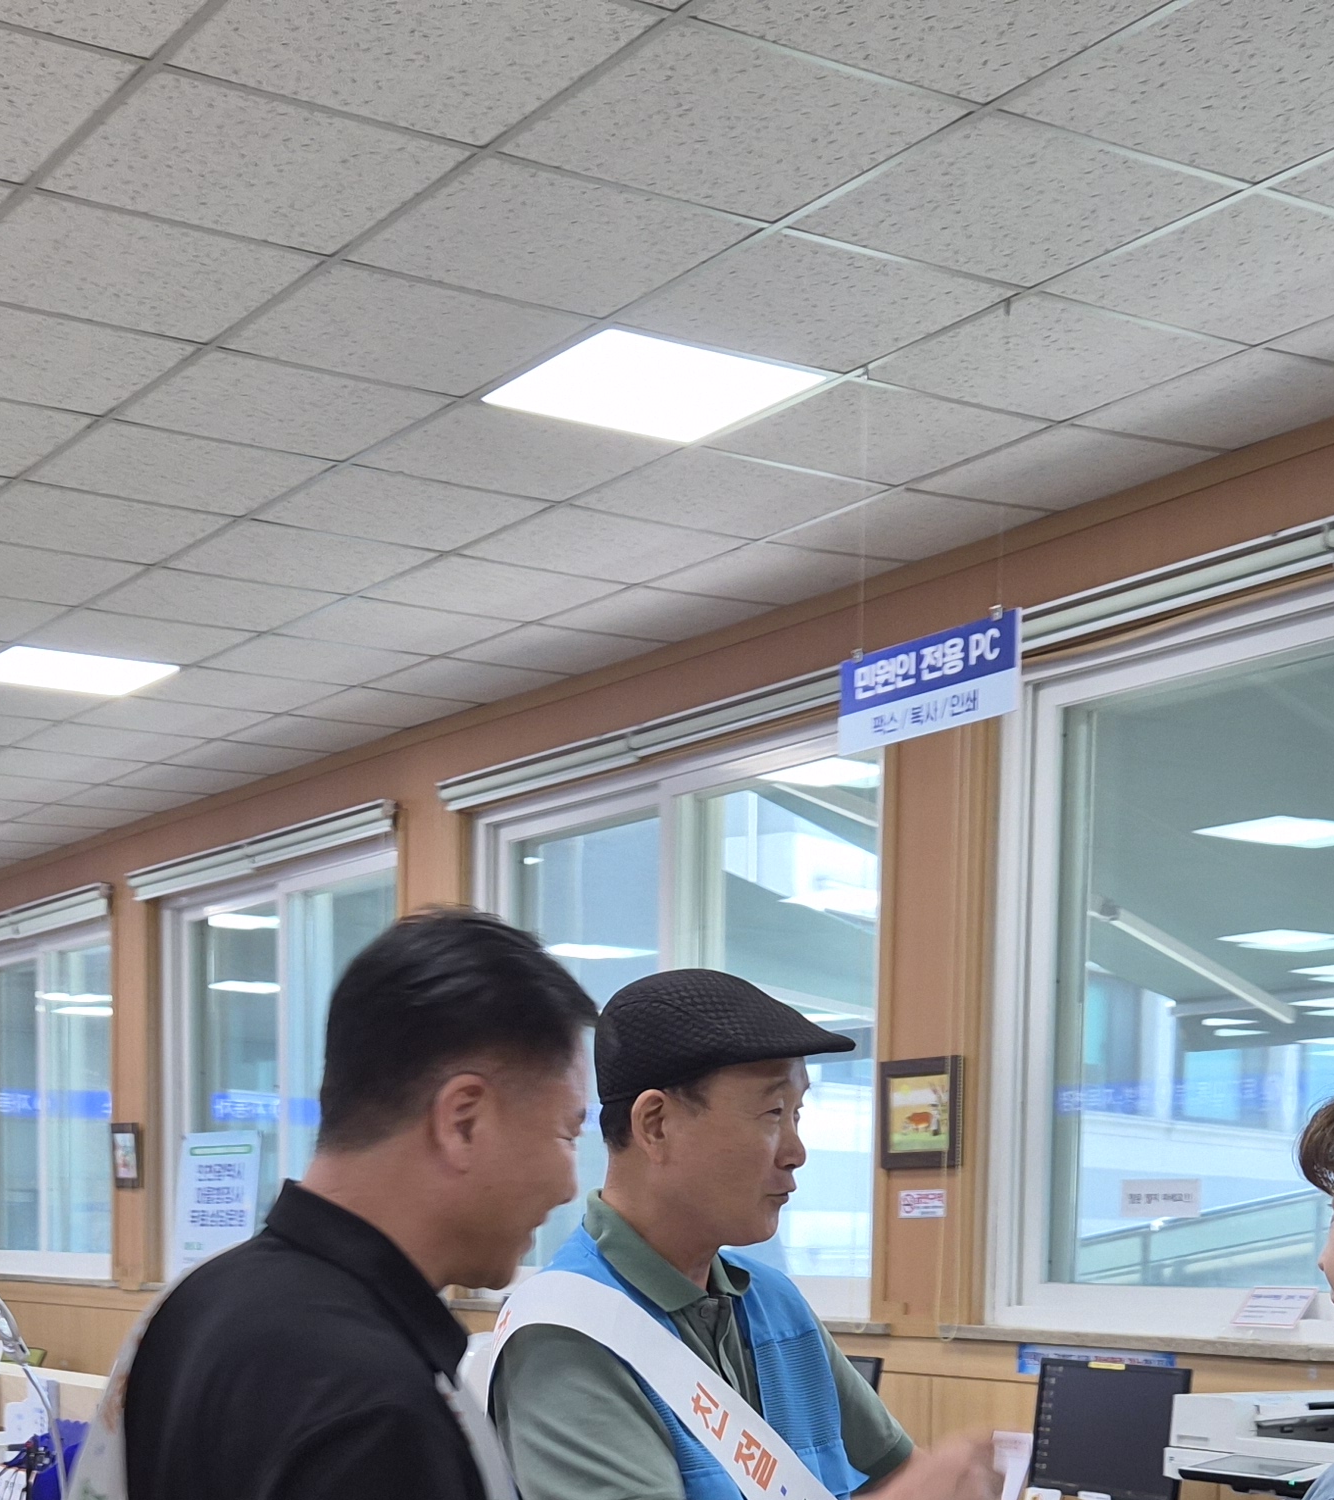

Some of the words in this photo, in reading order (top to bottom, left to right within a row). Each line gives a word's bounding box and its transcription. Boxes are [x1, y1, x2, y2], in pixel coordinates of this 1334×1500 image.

[854, 653, 916, 700] 민원인
[919, 637, 965, 681] 전용
[968, 627, 1001, 666] PC
[691, 1381, 779, 1491] 친절
